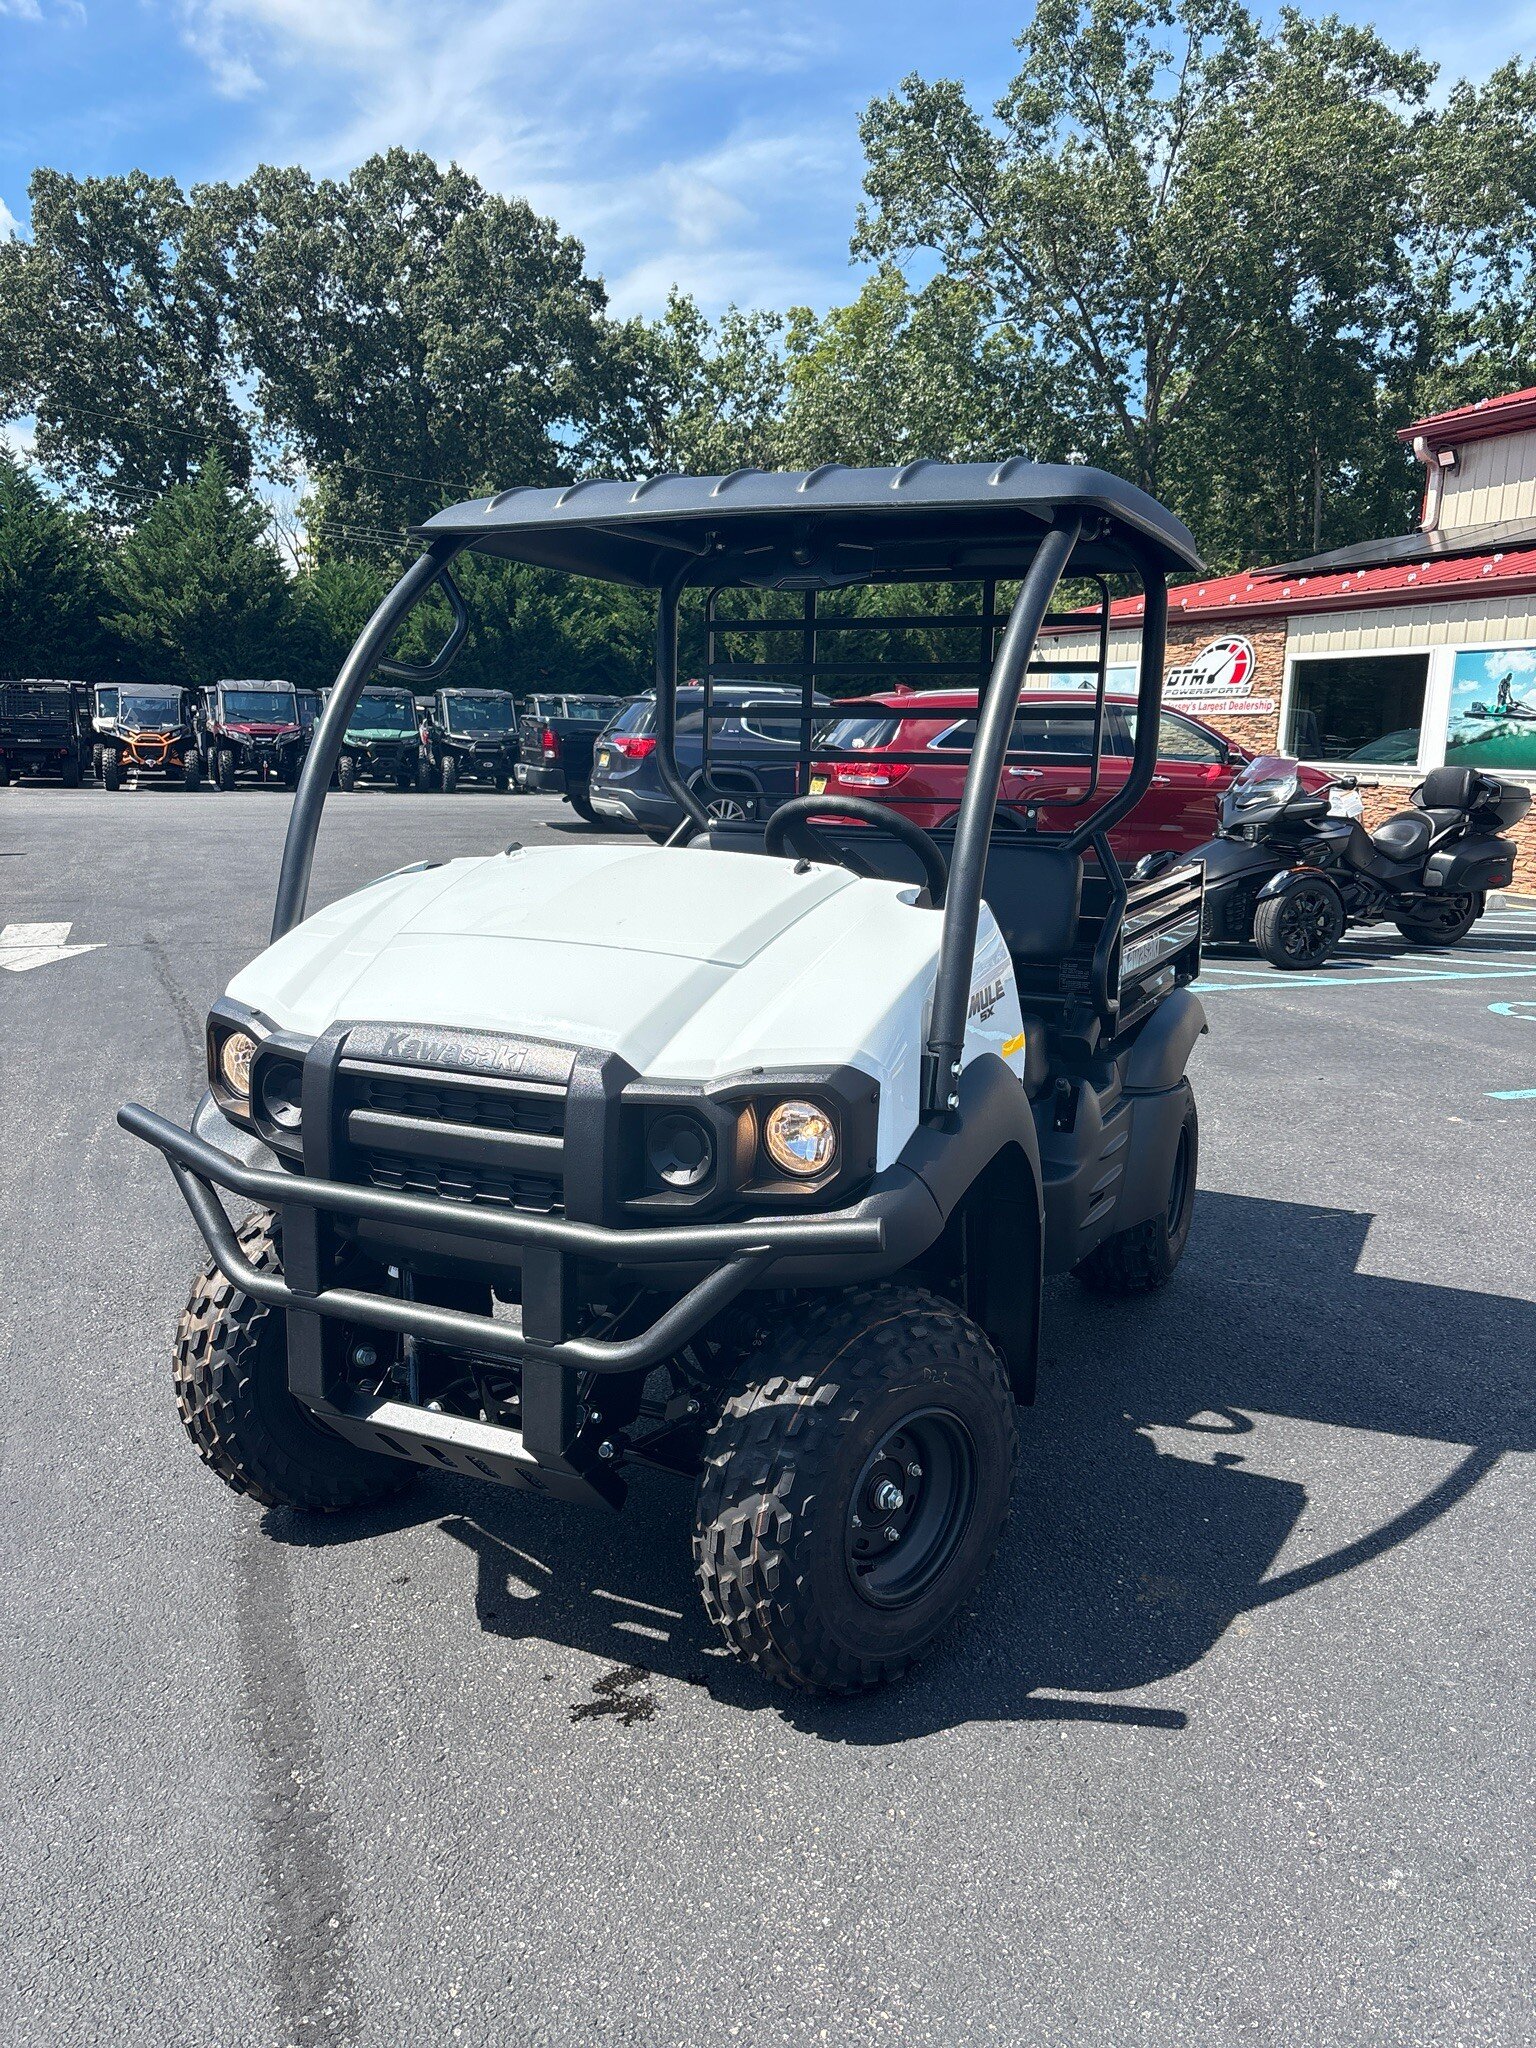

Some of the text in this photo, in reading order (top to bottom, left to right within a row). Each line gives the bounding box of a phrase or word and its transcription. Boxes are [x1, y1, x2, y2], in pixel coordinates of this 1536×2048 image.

[1167, 668, 1208, 686] DTM
[1164, 687, 1249, 695] POWERSPORTS
[1198, 701, 1226, 712] Largest
[1229, 700, 1272, 713] Dealership
[968, 979, 1005, 1019] MULE
[980, 1005, 995, 1022] SX
[381, 1032, 529, 1072] Kawasaki
